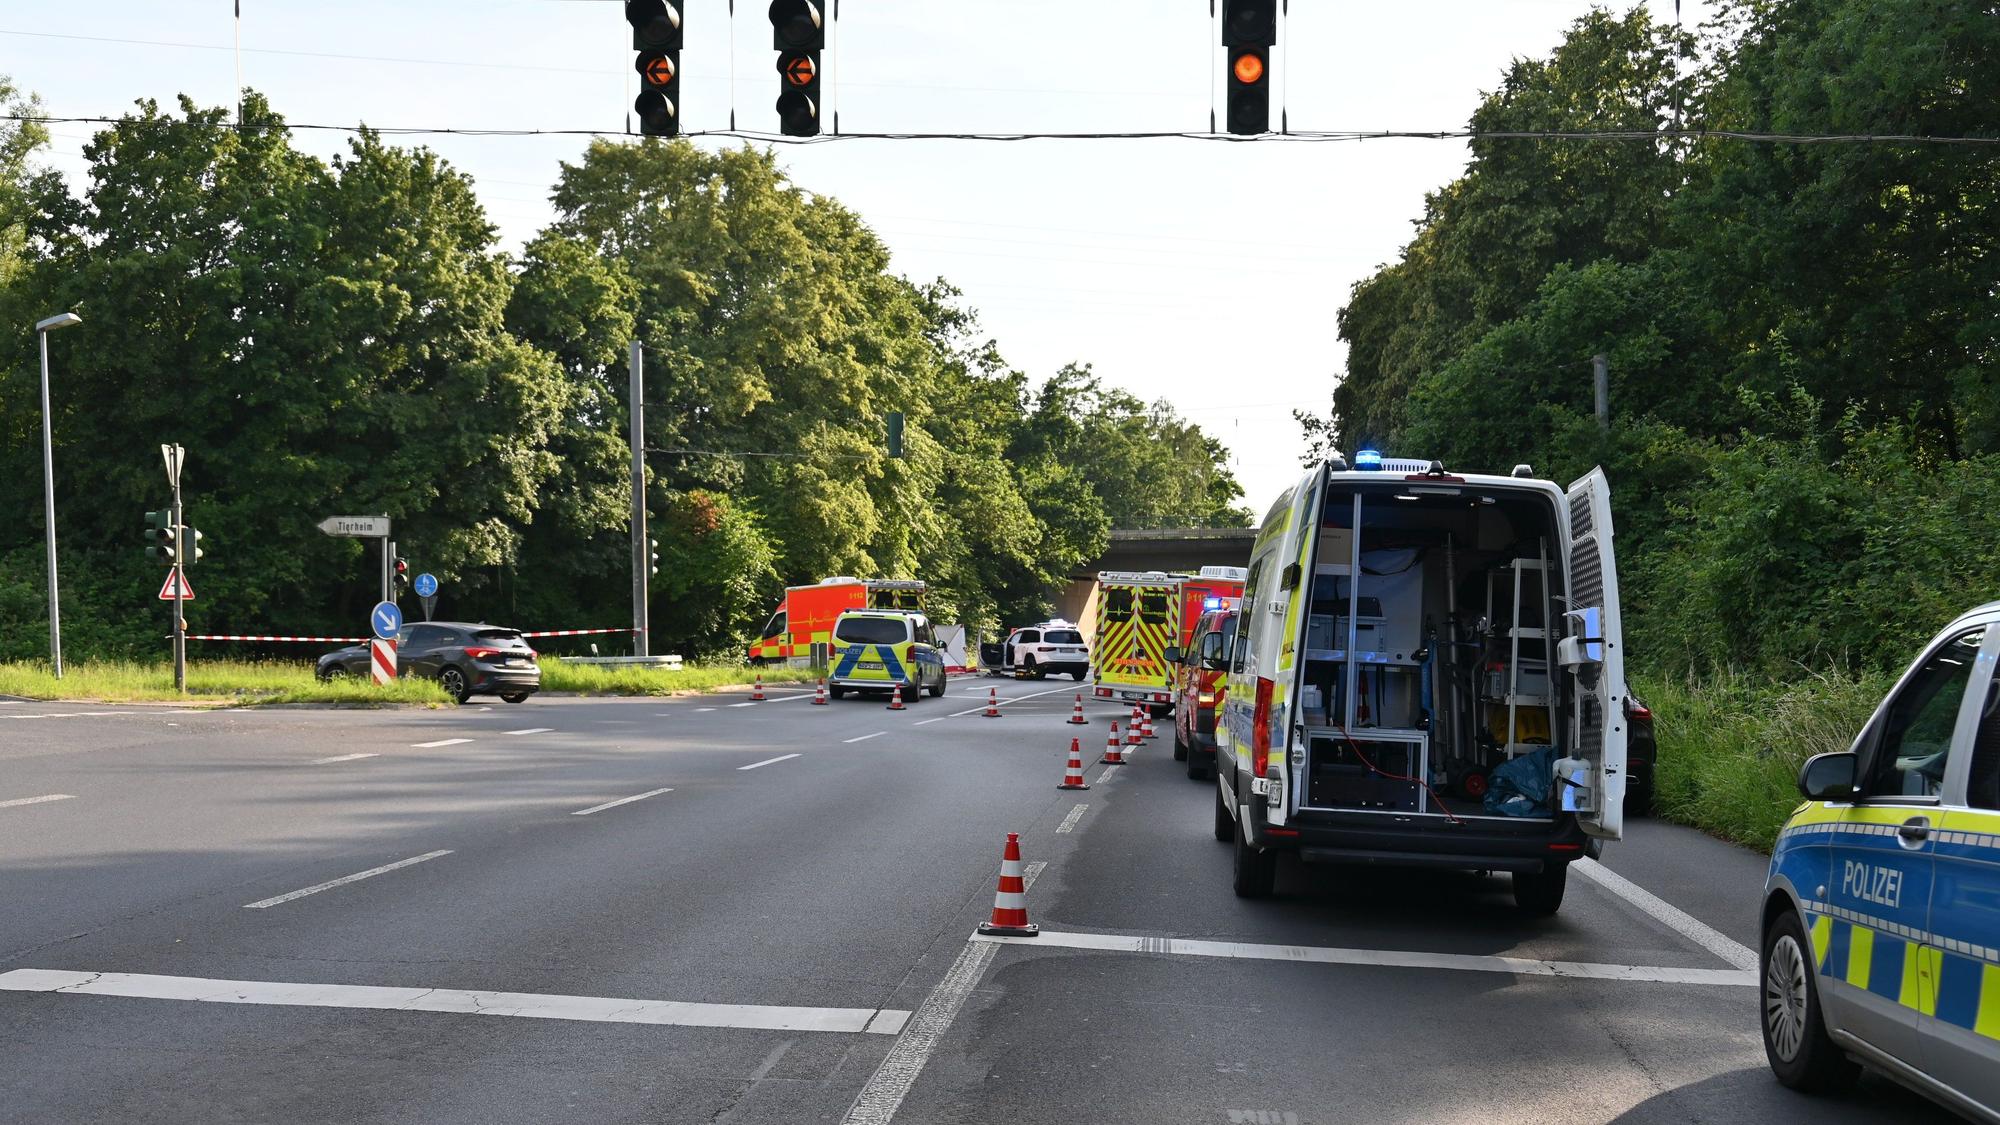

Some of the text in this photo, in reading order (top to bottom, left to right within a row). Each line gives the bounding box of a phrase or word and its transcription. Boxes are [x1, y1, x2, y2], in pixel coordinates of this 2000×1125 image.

[338, 521, 373, 532] Tierheim
[836, 647, 862, 655] POLIZEI
[1842, 859, 1903, 909] POLIZEI
